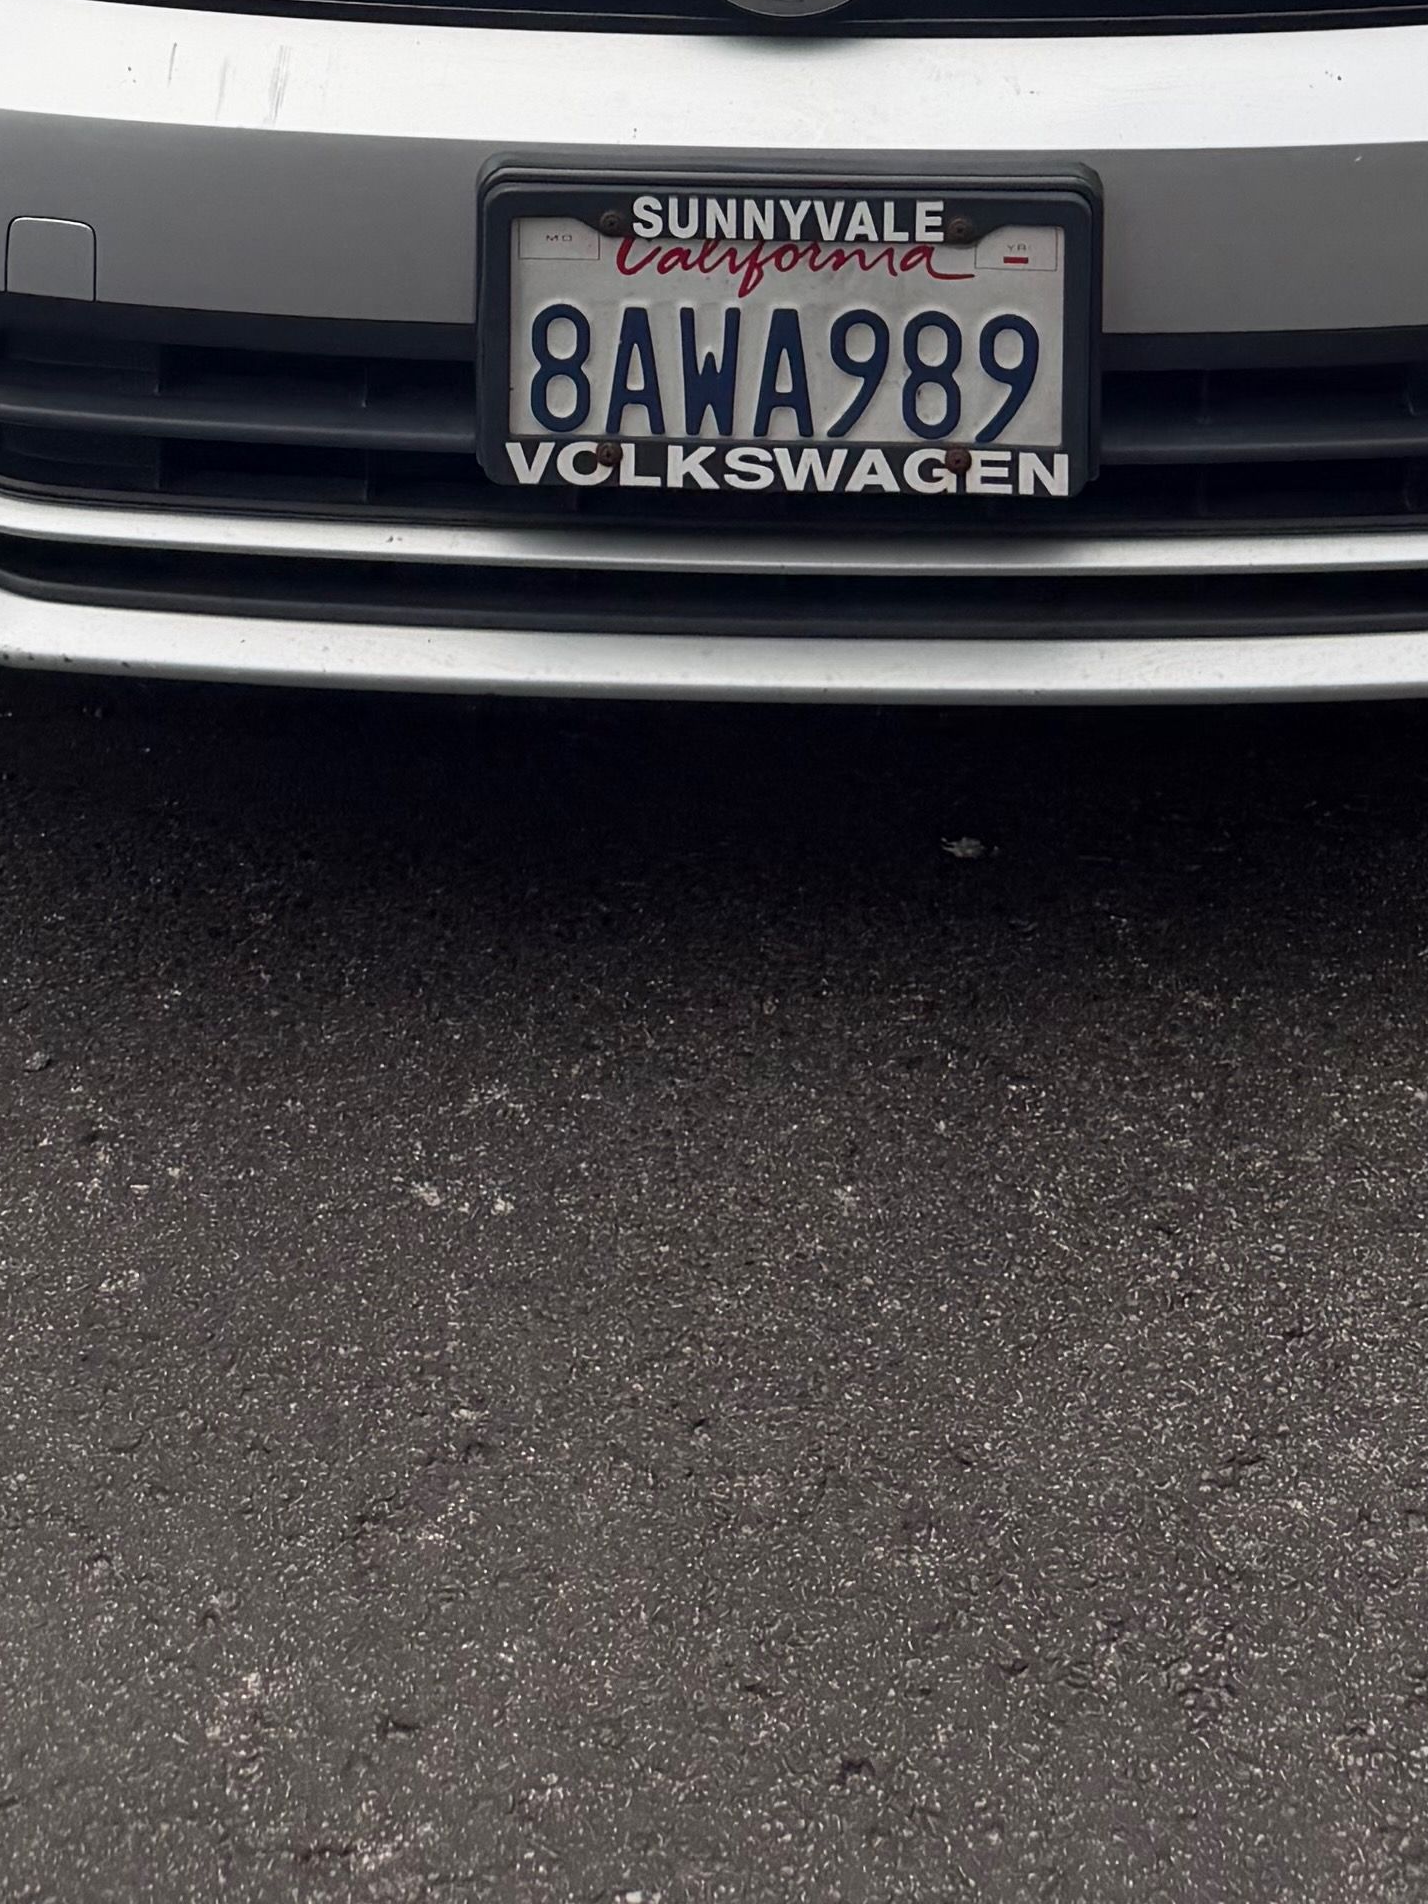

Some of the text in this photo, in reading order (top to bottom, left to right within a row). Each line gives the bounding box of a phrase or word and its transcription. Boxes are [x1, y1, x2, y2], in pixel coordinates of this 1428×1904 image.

[632, 195, 945, 242] SUNNYVALE
[616, 237, 975, 298] California
[530, 303, 1040, 444] 8AWA989
[505, 441, 1070, 497] VOLKSWAGEN
